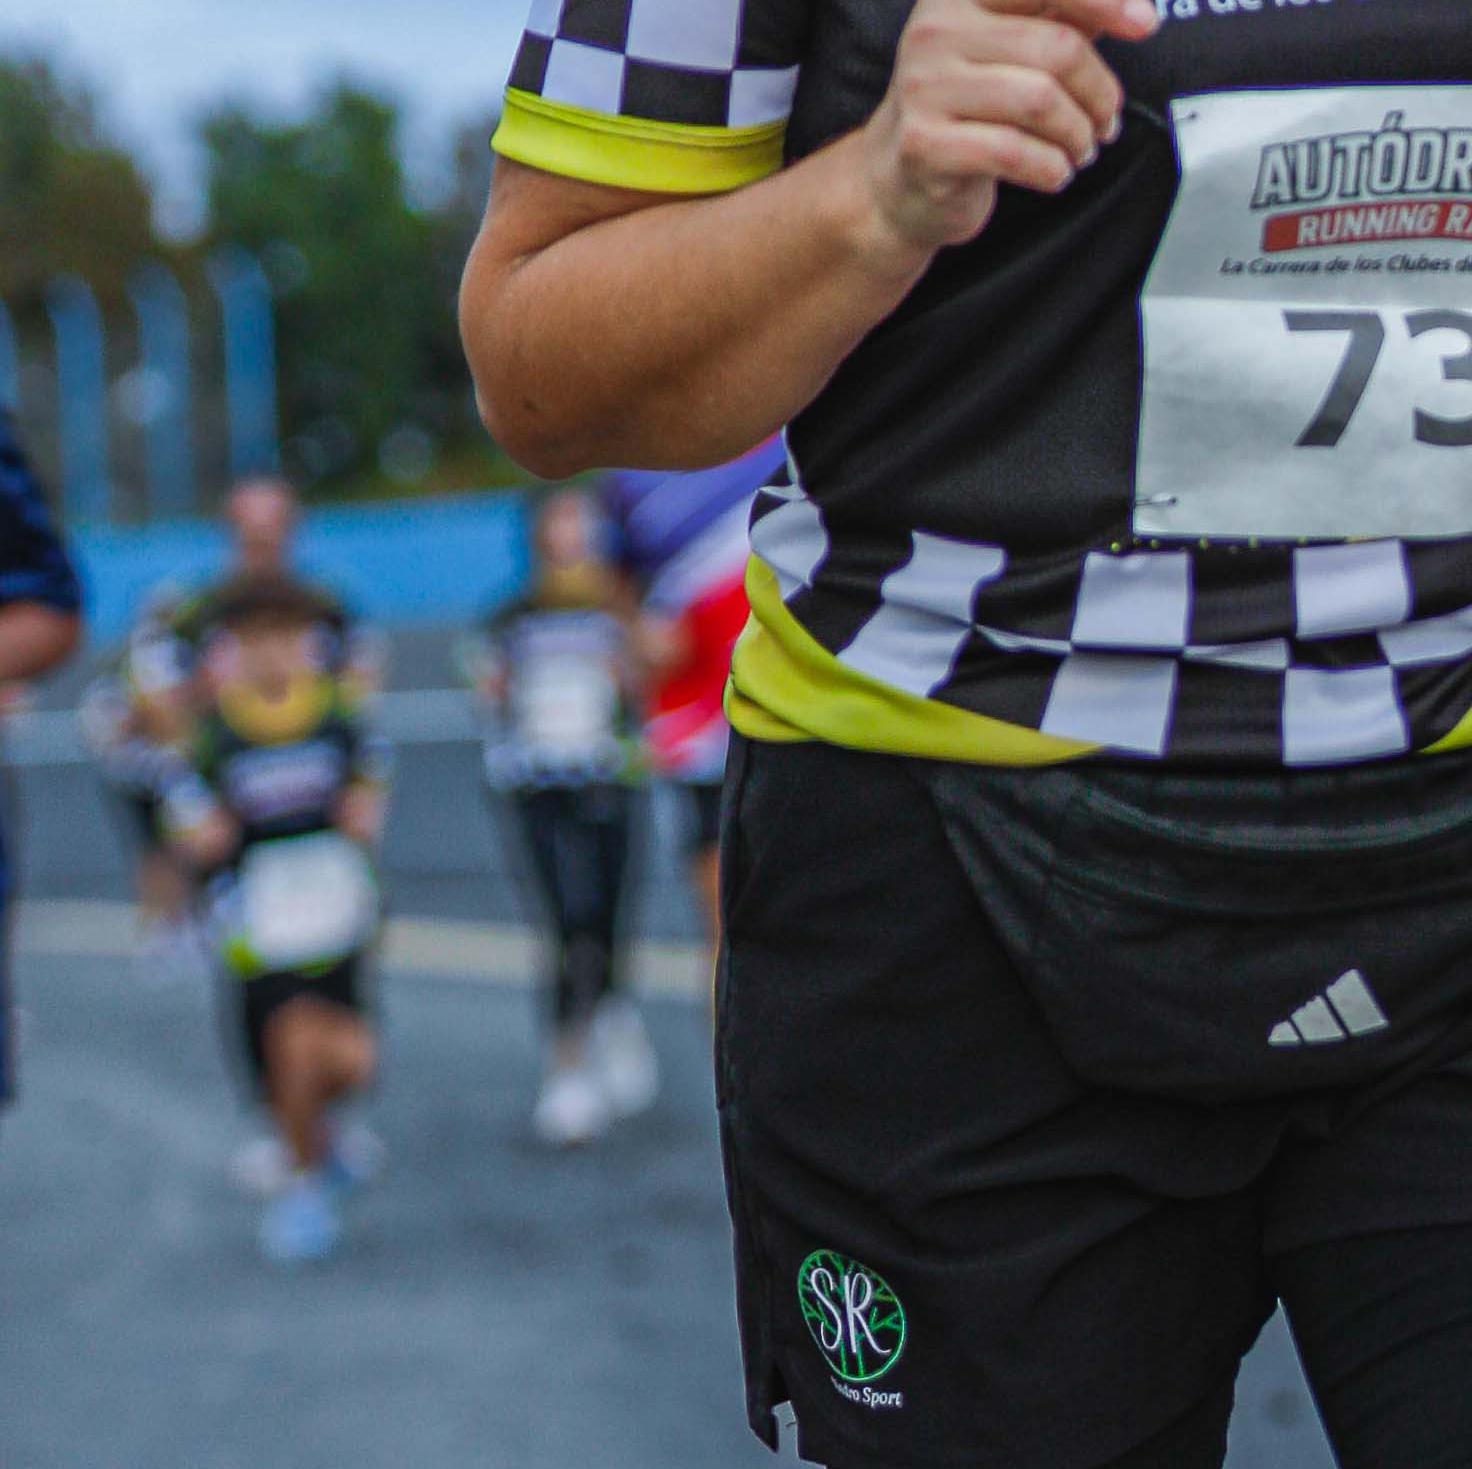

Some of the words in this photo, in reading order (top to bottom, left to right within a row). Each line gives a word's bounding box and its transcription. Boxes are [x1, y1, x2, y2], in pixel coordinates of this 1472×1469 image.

[1296, 203, 1441, 246] RUNNING
[1219, 257, 1244, 274] La
[1248, 257, 1321, 274] Carrera
[1325, 255, 1351, 272] de
[1353, 254, 1383, 272] los
[1386, 254, 1450, 272] Clubes
[811, 1267, 892, 1354] SR
[862, 1386, 902, 1408] Sport
